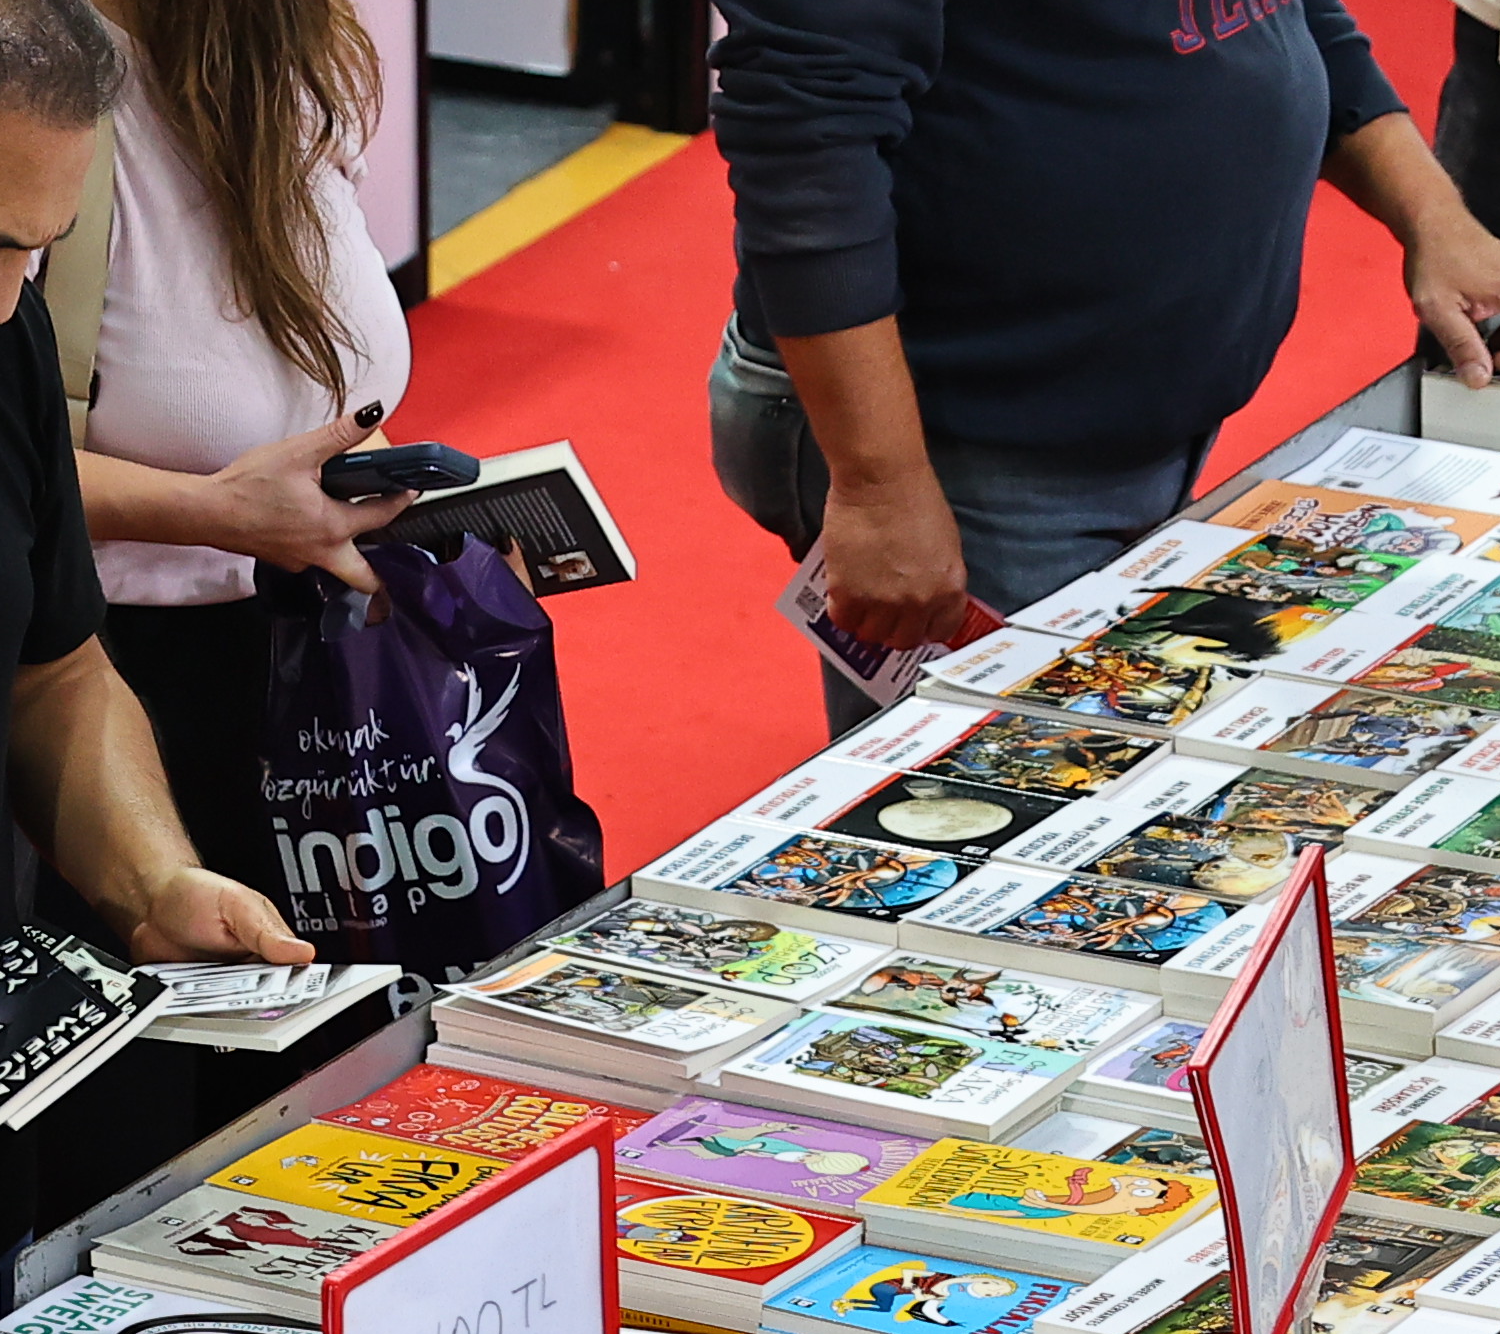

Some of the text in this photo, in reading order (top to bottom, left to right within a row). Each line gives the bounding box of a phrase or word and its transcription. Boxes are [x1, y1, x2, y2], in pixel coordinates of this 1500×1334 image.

[272, 795, 521, 900] indigo
[635, 995, 736, 1038] KAŞAĞI
[929, 1049, 1029, 1107] FALAKA
[438, 1090, 553, 1150] KUTUSU
[476, 1096, 597, 1159] BİLMECE
[313, 1156, 386, 1190] LAR
[337, 1151, 466, 1213] FIKRA
[246, 1217, 378, 1284] KARDEŞ
[662, 1201, 825, 1275] KARADENİZ
[512, 1273, 557, 1328] TL
[1055, 1291, 1116, 1324] DON KİŞOT
